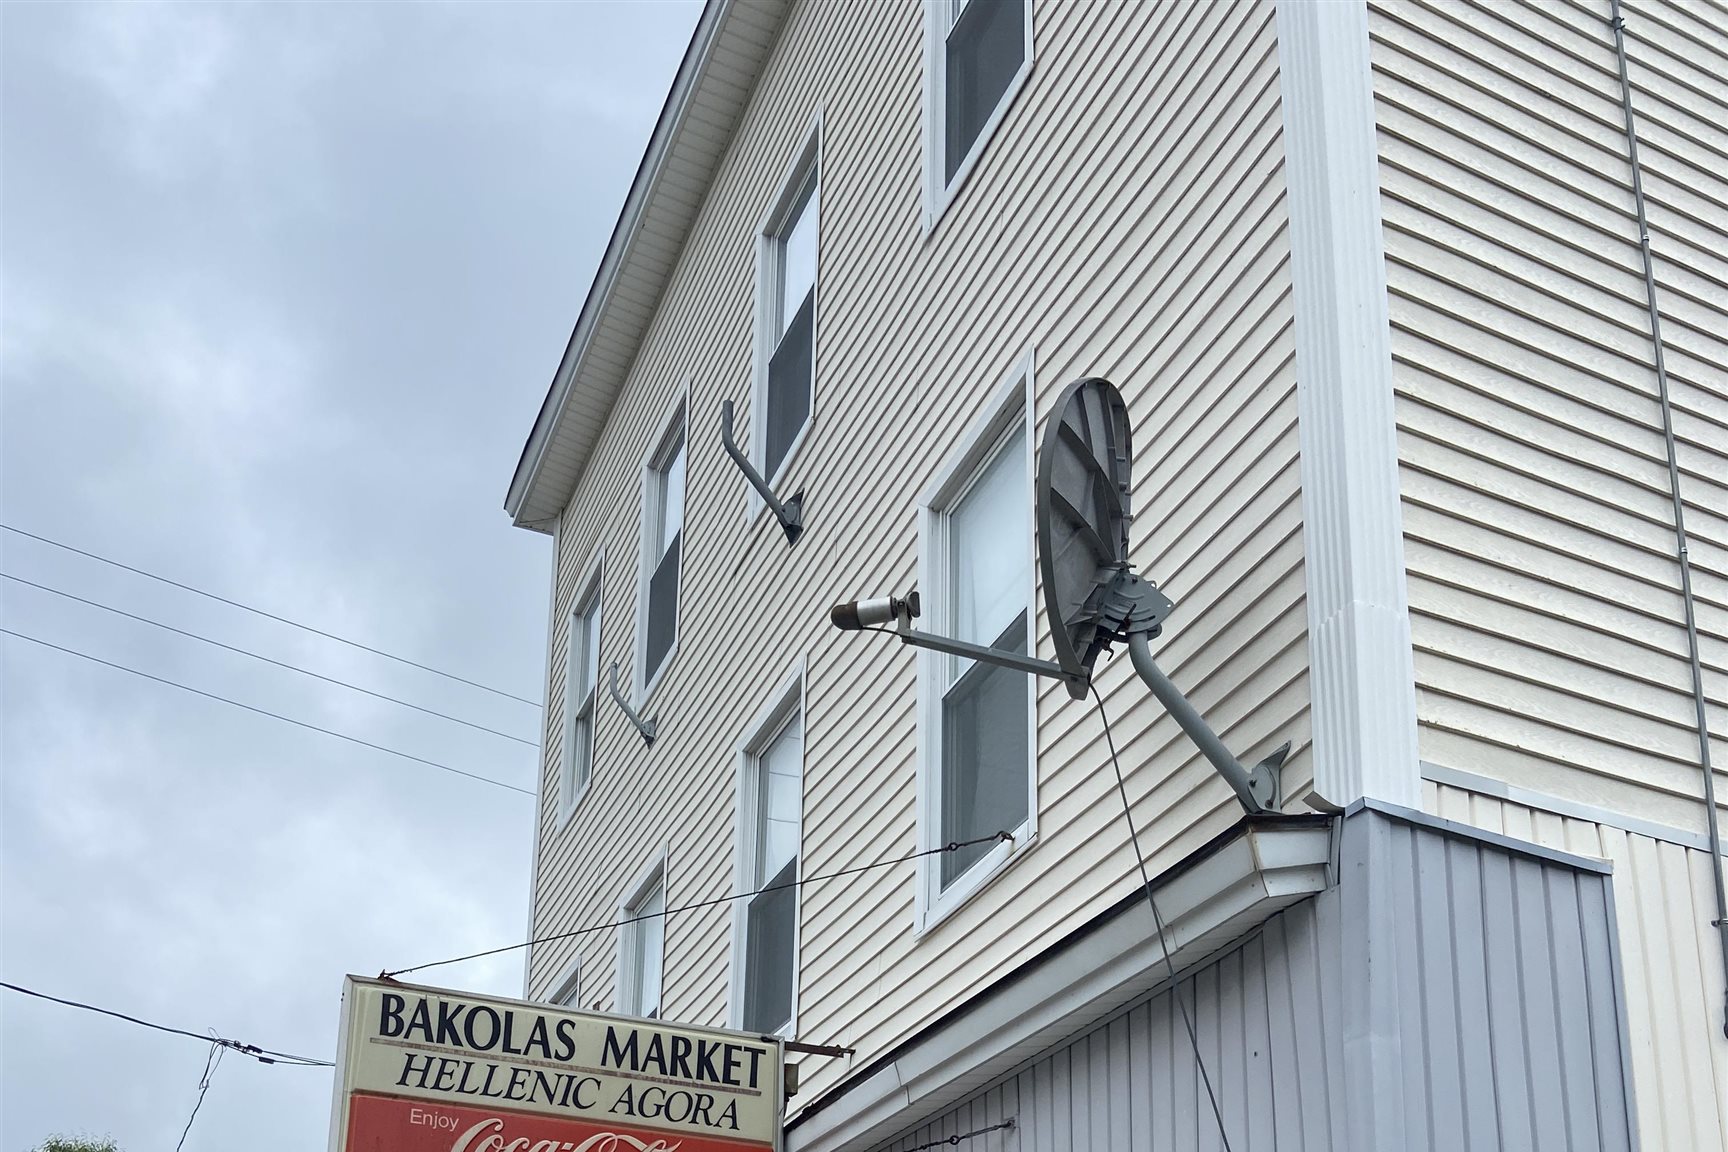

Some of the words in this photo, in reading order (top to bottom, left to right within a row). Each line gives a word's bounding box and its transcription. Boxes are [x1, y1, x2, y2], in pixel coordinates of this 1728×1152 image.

[379, 993, 576, 1062] BAKOLAS
[601, 1026, 767, 1088] MARKET
[396, 1053, 602, 1110] HELLENIC
[608, 1084, 740, 1131] AGORA
[410, 1108, 460, 1132] Enjoy
